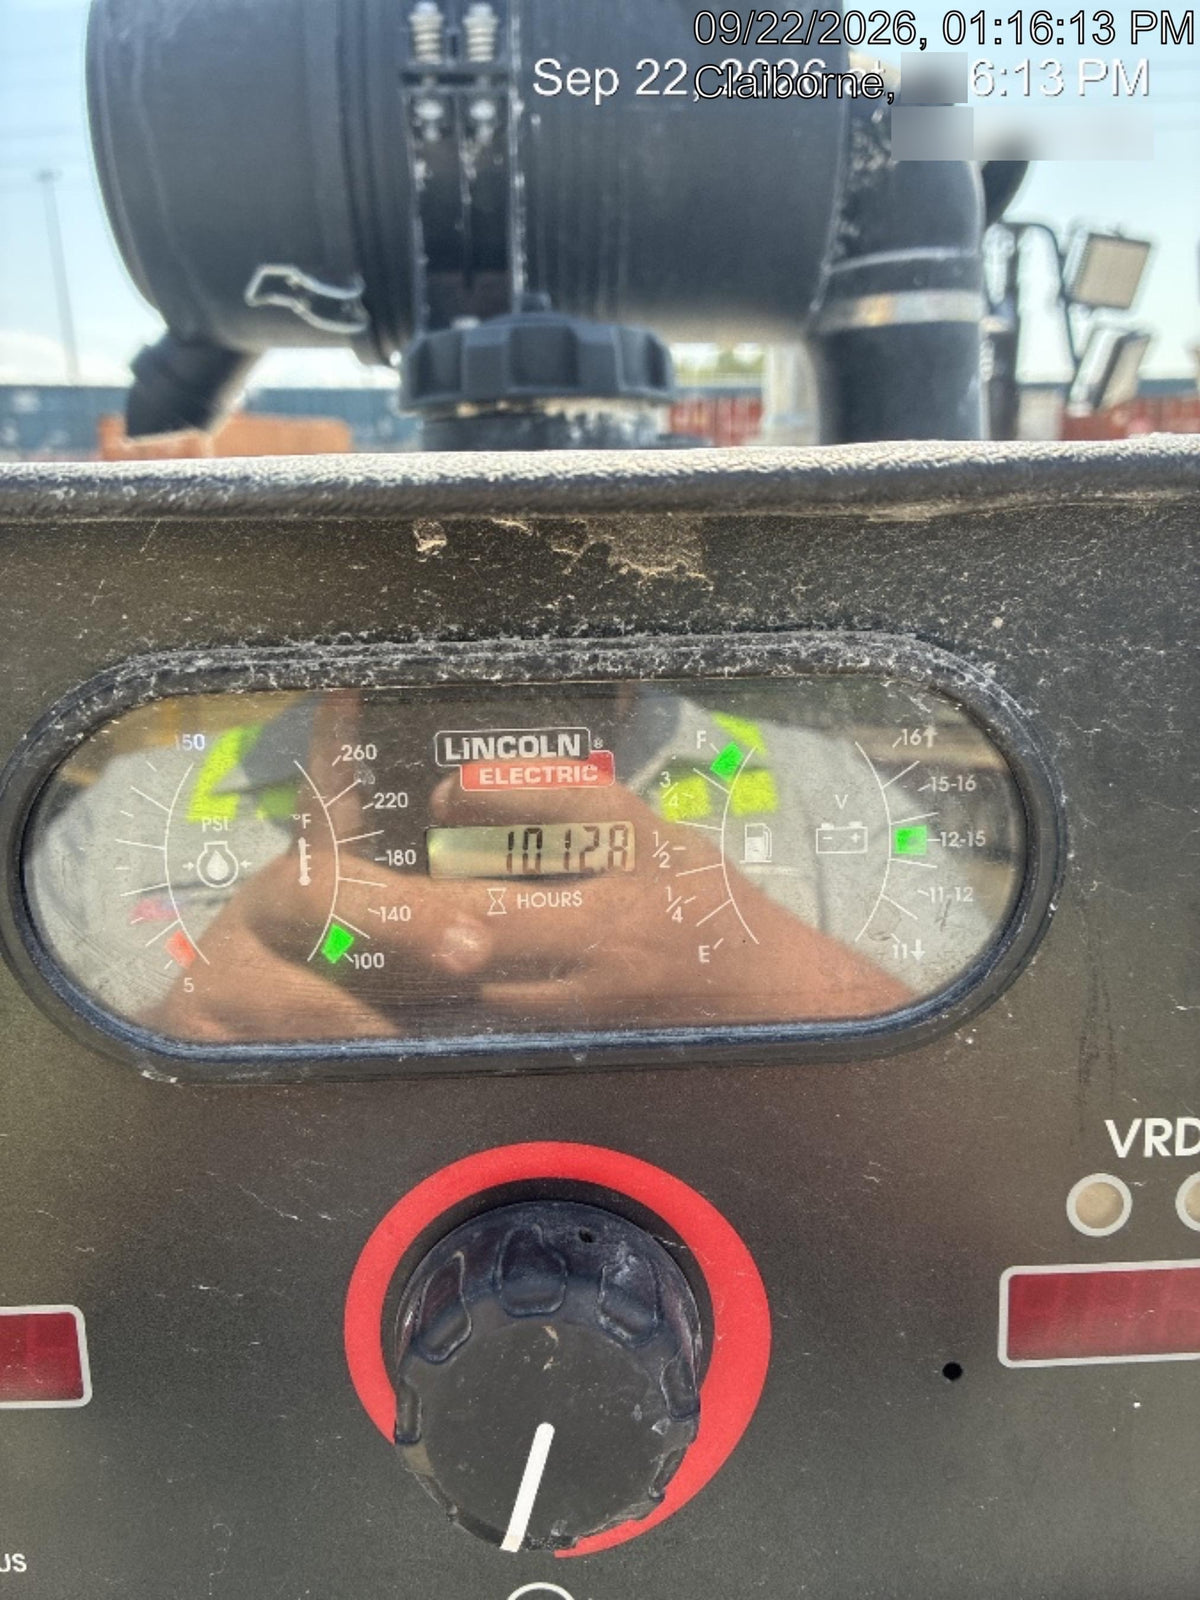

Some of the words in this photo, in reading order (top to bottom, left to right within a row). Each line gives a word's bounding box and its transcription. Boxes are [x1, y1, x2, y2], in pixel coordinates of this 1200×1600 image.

[696, 731, 706, 749] F
[901, 730, 922, 748] 16
[341, 744, 378, 761] 260
[479, 765, 599, 786] ELECTRIC
[930, 777, 977, 793] 15-16
[374, 792, 409, 809] 220
[834, 794, 849, 810] V
[201, 816, 230, 833] PSI
[939, 831, 987, 848] 12-15
[387, 849, 417, 866] 180
[516, 890, 584, 910] HOURS
[929, 886, 974, 903] 11-12
[380, 905, 412, 923] 140
[354, 952, 385, 970] 100
[698, 945, 710, 963] E
[183, 977, 194, 993] 5
[1104, 1117, 1200, 1158] VRD
